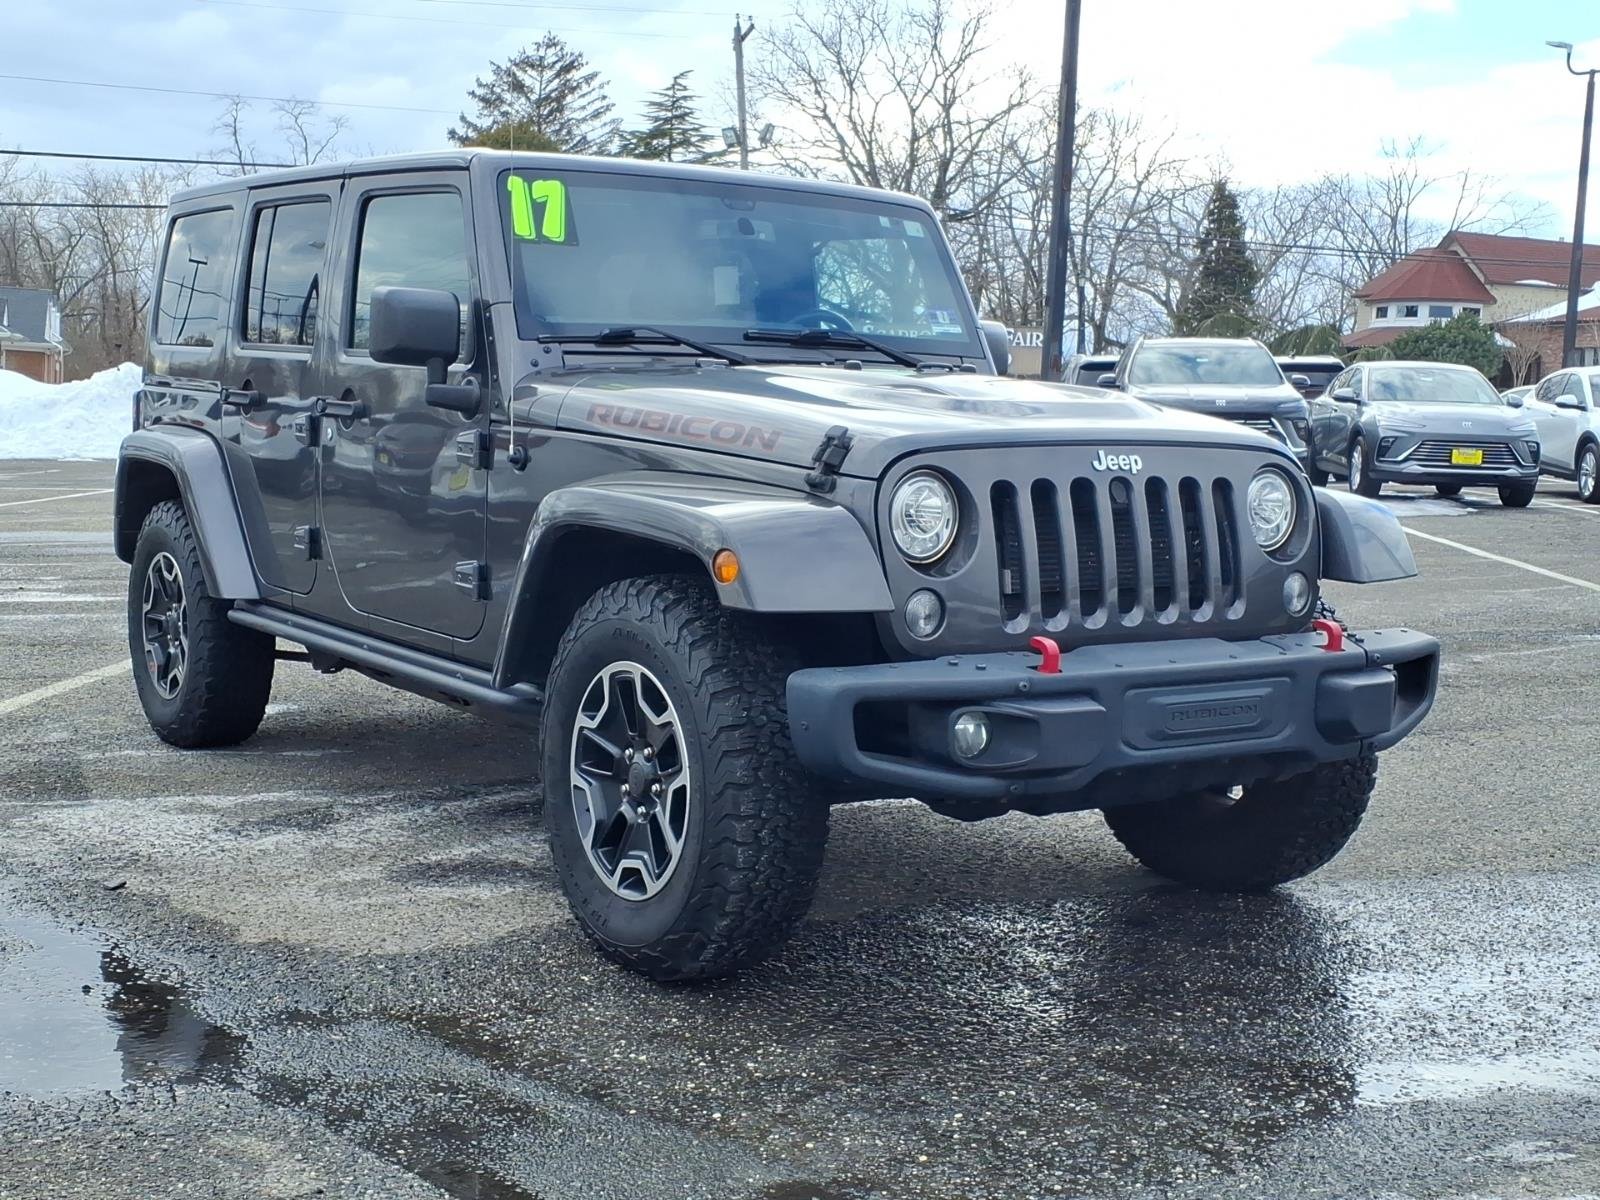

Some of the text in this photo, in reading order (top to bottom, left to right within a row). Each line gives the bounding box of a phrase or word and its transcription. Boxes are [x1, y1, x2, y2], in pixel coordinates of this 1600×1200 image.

[507, 176, 565, 242] 17
[584, 402, 783, 452] RUBICON
[1091, 449, 1143, 475] Jeep
[1171, 704, 1259, 721] RUBICON
